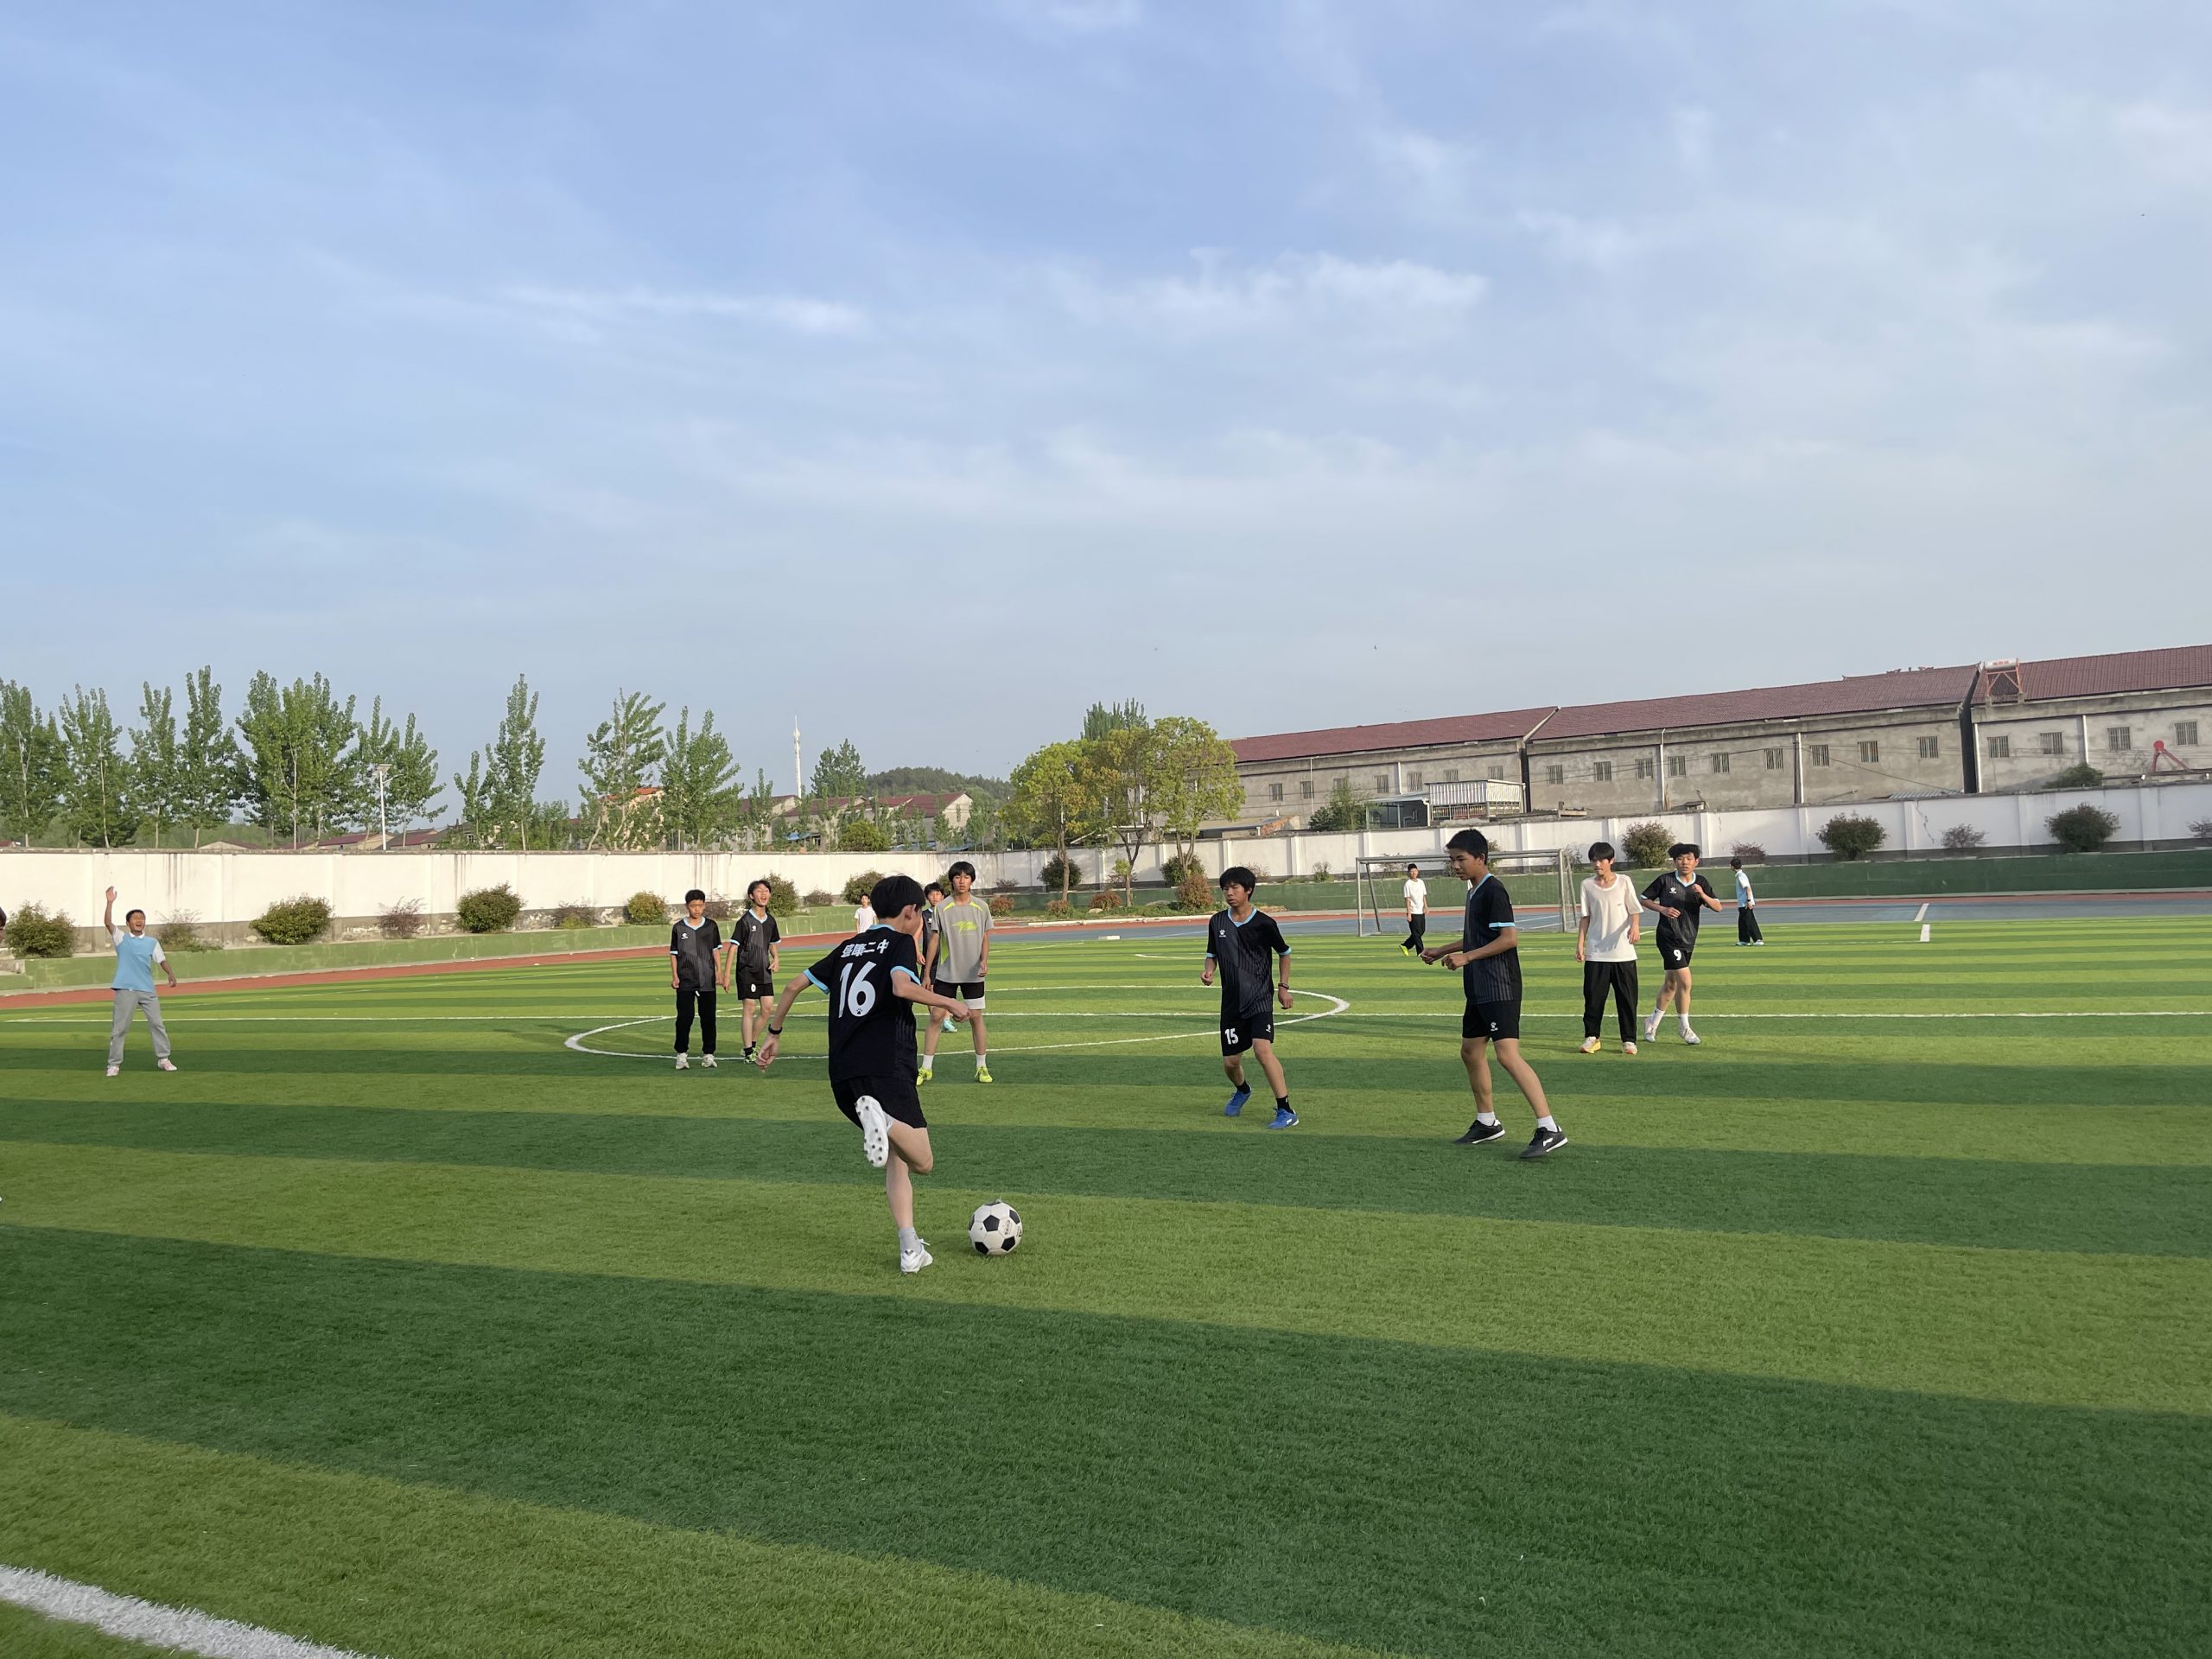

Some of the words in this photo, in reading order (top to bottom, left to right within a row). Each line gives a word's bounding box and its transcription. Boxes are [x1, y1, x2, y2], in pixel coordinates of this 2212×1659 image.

[1673, 949, 1682, 961] 9
[838, 960, 877, 1019] 16
[1224, 1027, 1239, 1045] 15
